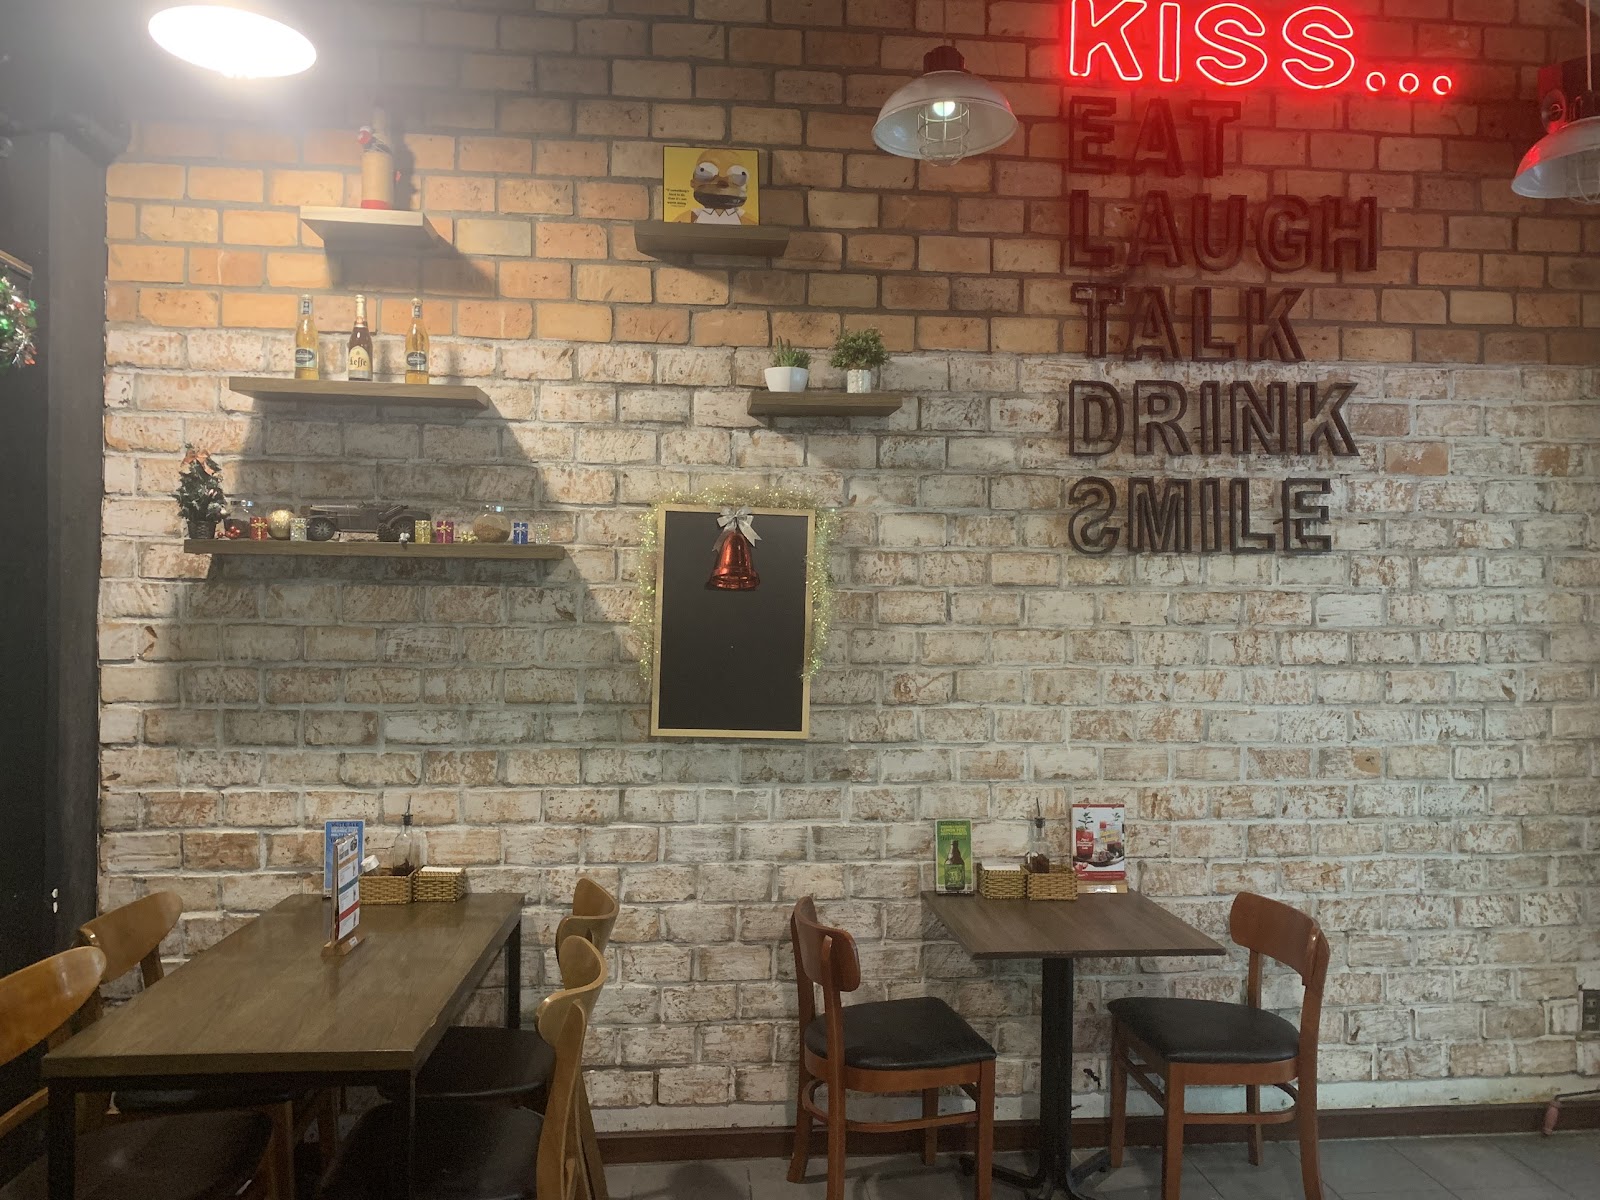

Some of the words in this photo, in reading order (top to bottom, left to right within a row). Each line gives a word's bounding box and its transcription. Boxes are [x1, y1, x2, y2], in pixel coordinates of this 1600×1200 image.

[1067, 95, 1242, 178] EAT
[1067, 189, 1378, 274] LAUGH
[1070, 282, 1306, 362] TALK
[1067, 379, 1361, 457] DRINK
[1067, 475, 1332, 555] SMILE
